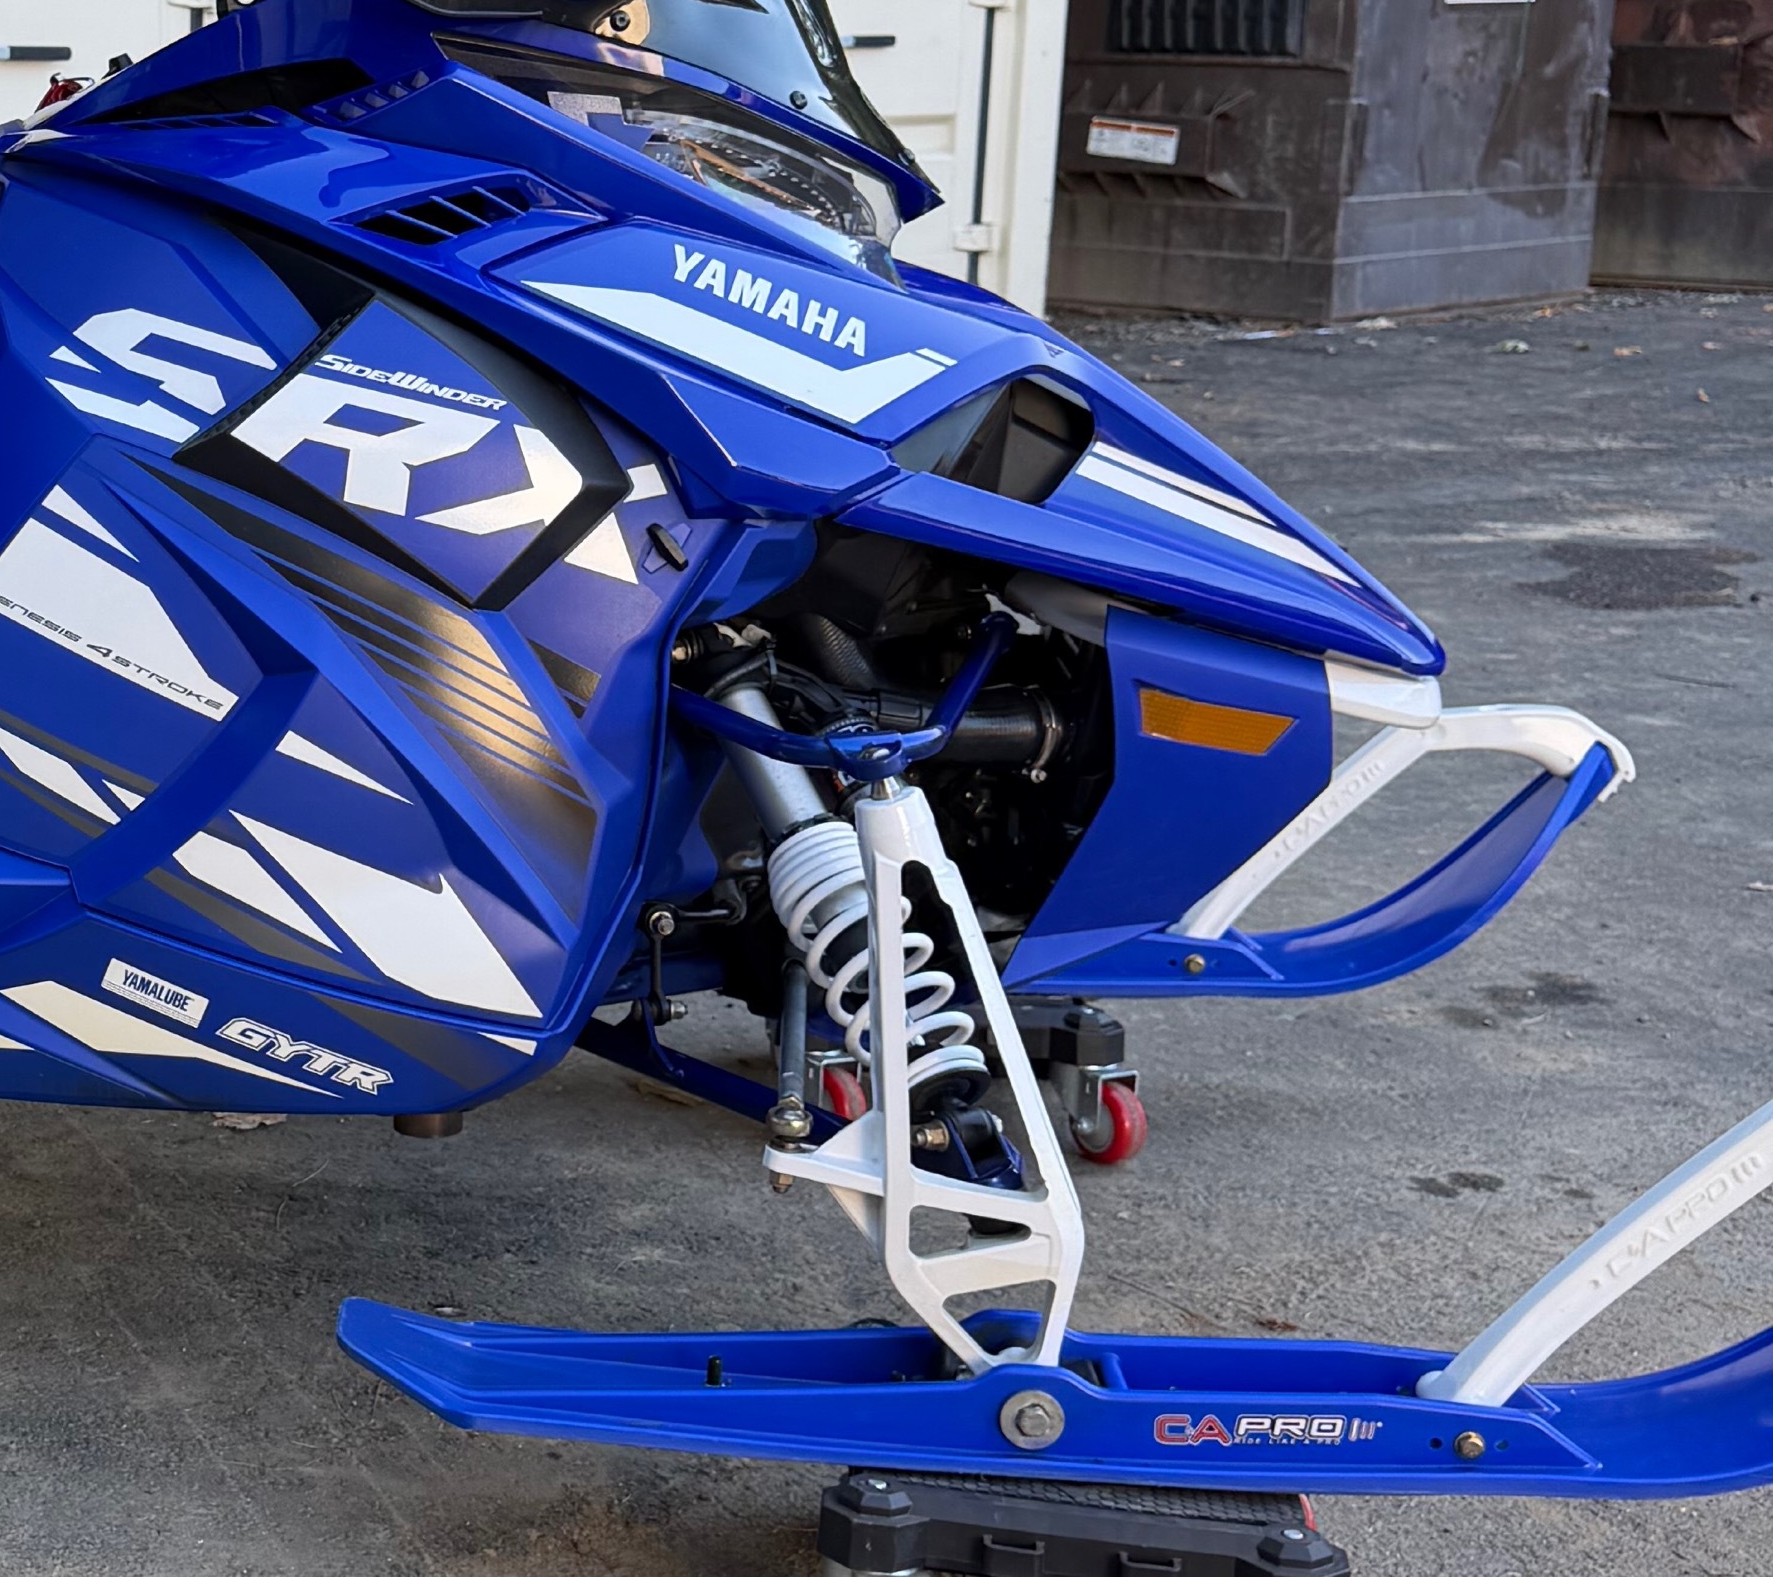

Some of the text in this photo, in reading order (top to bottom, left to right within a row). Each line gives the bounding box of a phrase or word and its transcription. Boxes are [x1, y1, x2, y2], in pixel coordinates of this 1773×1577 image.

[673, 243, 867, 358] YAMAHA
[122, 969, 193, 1012] YAMALUBE
[216, 1017, 394, 1095] GYTR
[1235, 1414, 1347, 1440] PRO
